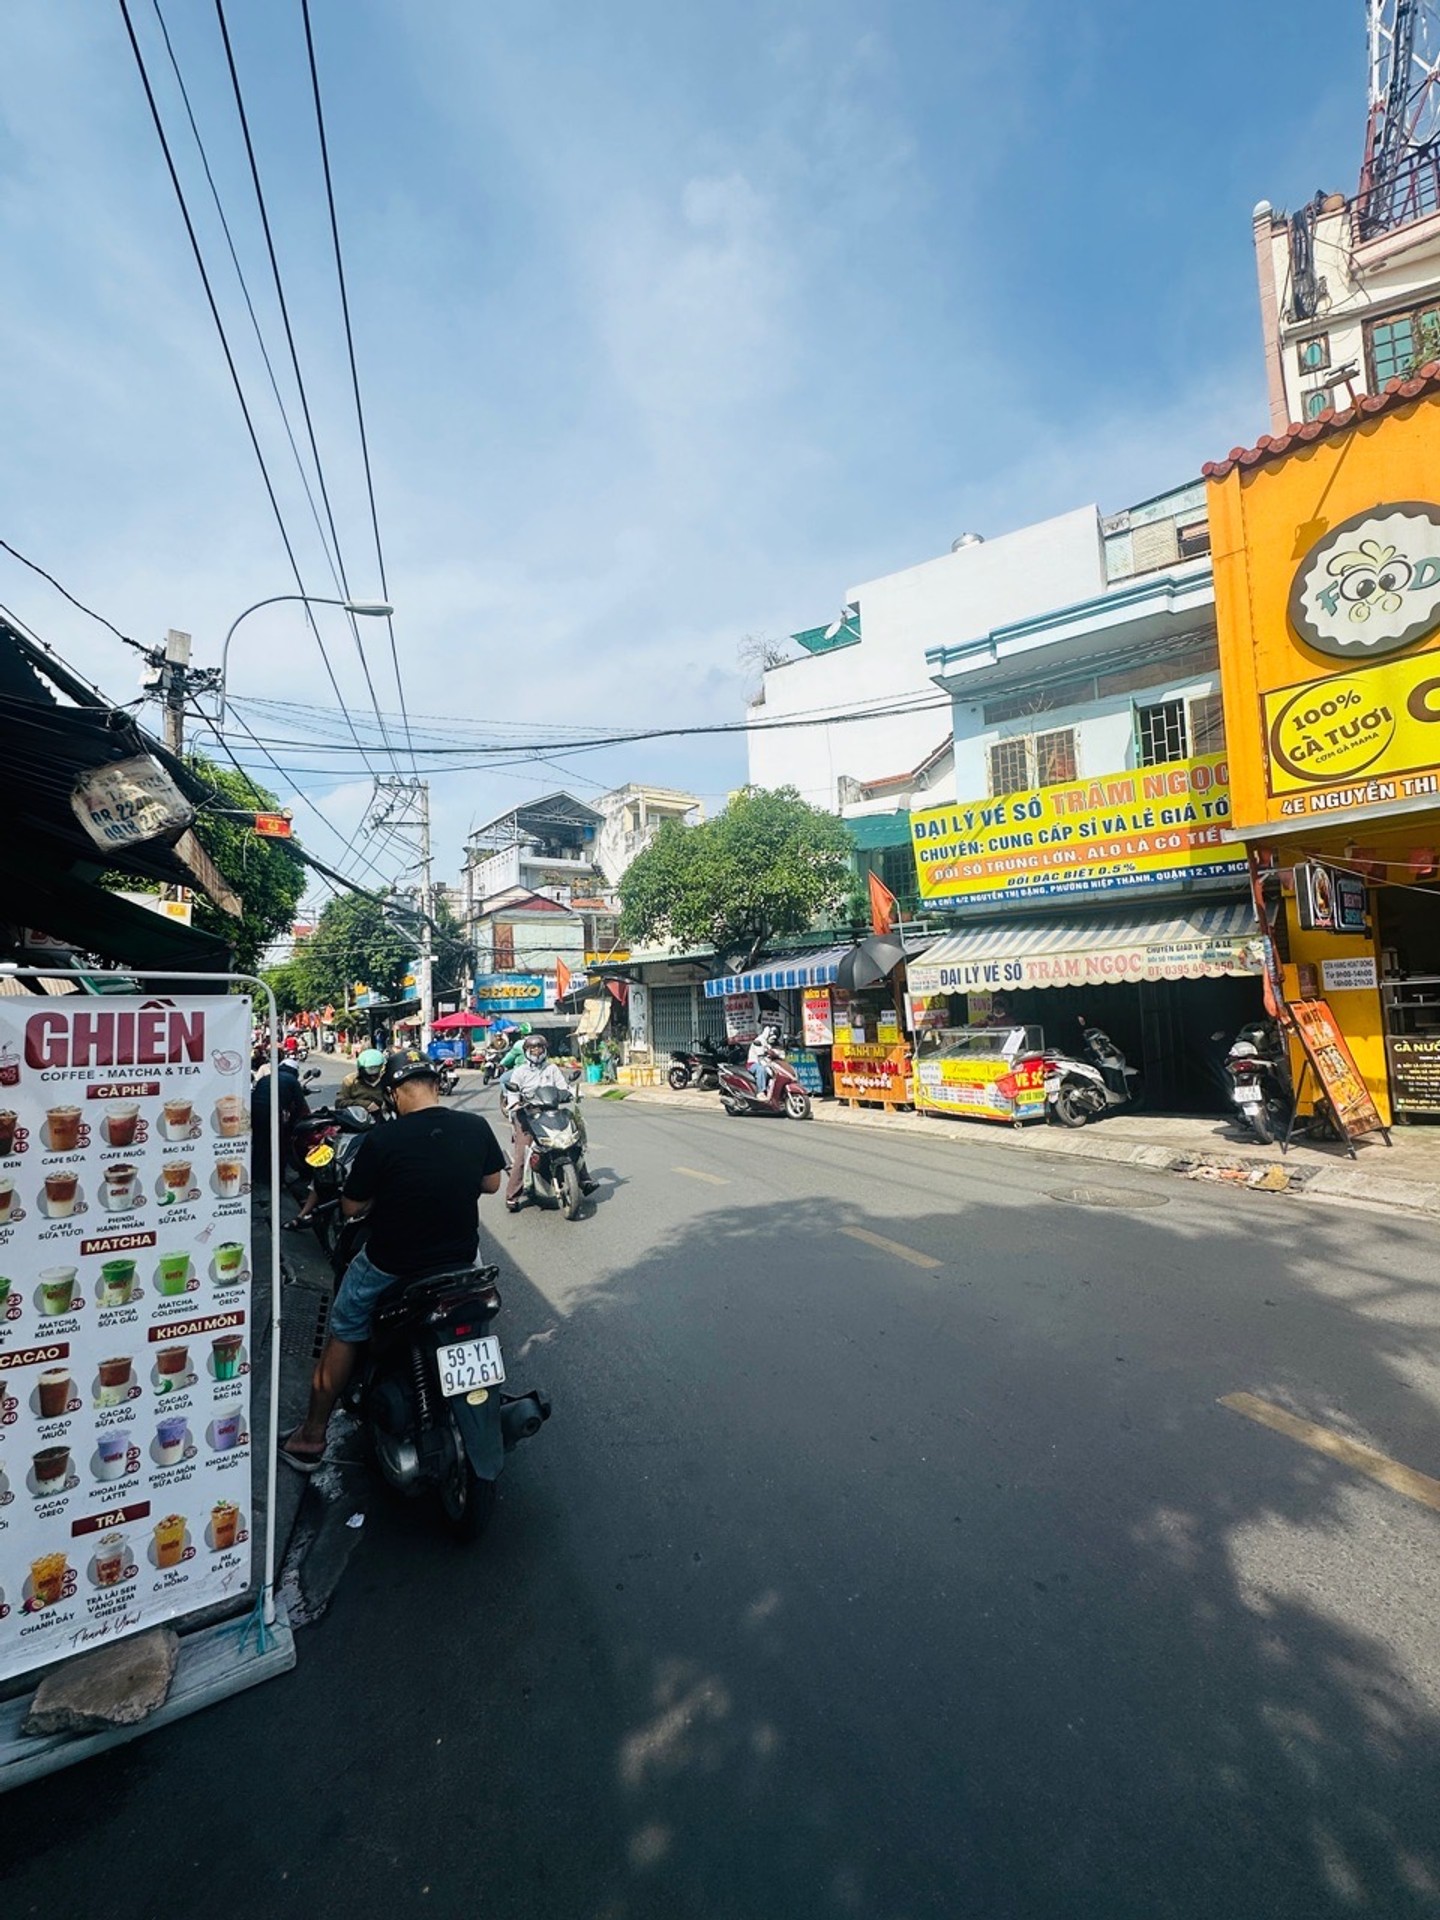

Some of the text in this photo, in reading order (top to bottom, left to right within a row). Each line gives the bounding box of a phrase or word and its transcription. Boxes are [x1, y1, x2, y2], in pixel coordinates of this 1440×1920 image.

[1292, 689, 1362, 731] 100%
[1289, 706, 1393, 762] GÀ TƯƠI
[1315, 731, 1380, 764] CƠM GÀ MAMA
[914, 760, 1230, 841] ĐẠI LÝ VÉ SỐ TRÂM NGỌC
[1281, 775, 1438, 815] 4E NGUYỄN THỊ
[988, 831, 1035, 852] CUNG
[1038, 821, 1074, 845] CẤP
[1101, 814, 1128, 835] VÀ
[1131, 807, 1155, 830] LẺ
[1160, 802, 1197, 826] GIÁ
[963, 859, 983, 877] SỐ
[1087, 844, 1122, 861] ALO
[1126, 836, 1150, 855] LÀ
[1154, 831, 1182, 850] CÓ
[1156, 868, 1187, 881] QUẬN
[940, 968, 962, 990] ĐẠI
[965, 962, 980, 984] LÝ
[983, 960, 1000, 983] VÉ
[1004, 956, 1024, 981] SỐ
[1025, 955, 1081, 981] TRÂM
[1084, 953, 1142, 978] NGỌC
[1165, 963, 1190, 976] 0395
[478, 983, 541, 999] SENKO
[1394, 1040, 1412, 1052] GÀ
[40, 1069, 95, 1082] COFFEE
[107, 1067, 162, 1079] MATCHA
[164, 1067, 174, 1076] &
[177, 1066, 201, 1075] TEA
[97, 1082, 149, 1098] CÀ PHÊ
[78, 1126, 90, 1134] 15
[136, 1121, 147, 1130] 20
[16, 1130, 28, 1139] 12
[16, 1143, 28, 1152] 15
[78, 1138, 90, 1147] 20
[42, 1157, 64, 1165] CAFE
[100, 1152, 122, 1160] CAFE
[212, 1208, 248, 1218] CARAMEL
[86, 1234, 152, 1253] MATCHA
[212, 1289, 246, 1300] MATCHA
[8, 1296, 21, 1306] 23
[157, 1298, 193, 1310] MATCHA
[218, 1298, 240, 1306] OREO
[8, 1308, 20, 1318] 40
[98, 1308, 138, 1320] MATCHA
[38, 1318, 78, 1330] MATCHA
[34, 1330, 54, 1338] KEM
[156, 1322, 202, 1340] KHOAI
[0, 1346, 60, 1368] CACAO
[444, 1361, 500, 1392] 942.61
[213, 1382, 242, 1394] CACAO
[4, 1400, 17, 1410] 23
[158, 1394, 189, 1407] CACAO
[4, 1414, 17, 1424] 40
[99, 1407, 132, 1420] CACAO
[37, 1420, 72, 1433] CACAO
[128, 1449, 140, 1459] 23
[127, 1462, 140, 1472] 40
[148, 1470, 176, 1482] KHOAI
[89, 1486, 117, 1498] KHOAI
[101, 1490, 126, 1502] LATTE
[34, 1498, 69, 1512] CACAO
[38, 1508, 64, 1520] OREO
[96, 1510, 126, 1529] TRÀ
[184, 1548, 195, 1558] 25
[63, 1571, 77, 1582] 20
[124, 1566, 138, 1578] 30
[62, 1585, 76, 1598] 30
[120, 1584, 136, 1596] SEN
[116, 1593, 134, 1604] KEM
[40, 1609, 57, 1621] TRÀ
[94, 1602, 128, 1619] CHEESE
[20, 1620, 54, 1637] CHANH
